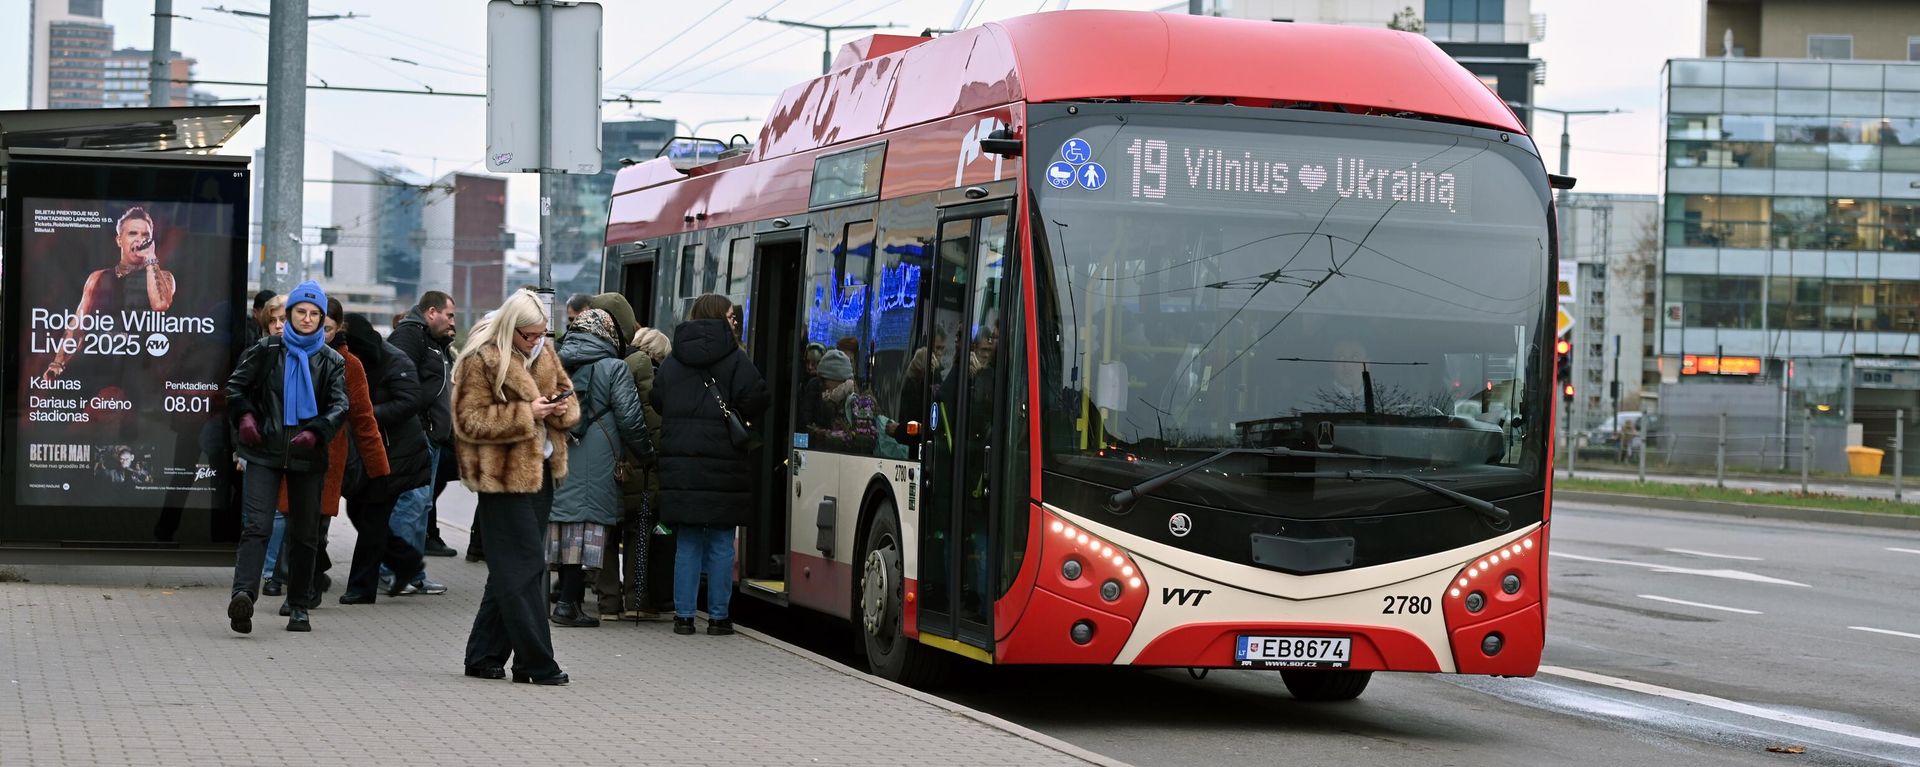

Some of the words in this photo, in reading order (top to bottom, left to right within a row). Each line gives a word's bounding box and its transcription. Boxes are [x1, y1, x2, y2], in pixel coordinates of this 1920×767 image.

[1127, 138, 1167, 199] 19
[1184, 147, 1289, 195] Vilnius
[1336, 157, 1456, 213] Ukrainą
[32, 308, 115, 332] Robbie
[121, 310, 215, 333] Williams
[31, 333, 77, 354] Live
[84, 333, 140, 355] 2025
[146, 340, 169, 350] RW
[30, 376, 81, 390] Kaunas
[165, 381, 219, 391] Penktadienis
[29, 396, 76, 409] Dariaus
[79, 397, 88, 409] ir
[90, 397, 132, 410] Girėno
[164, 396, 211, 413] 08.01
[29, 410, 90, 422] stadionas
[30, 444, 67, 462] BETTER
[68, 444, 90, 462] MAN
[194, 467, 217, 482] felix
[895, 464, 907, 482] 2780
[1383, 595, 1432, 615] 2780
[1263, 639, 1343, 659] EB8674
